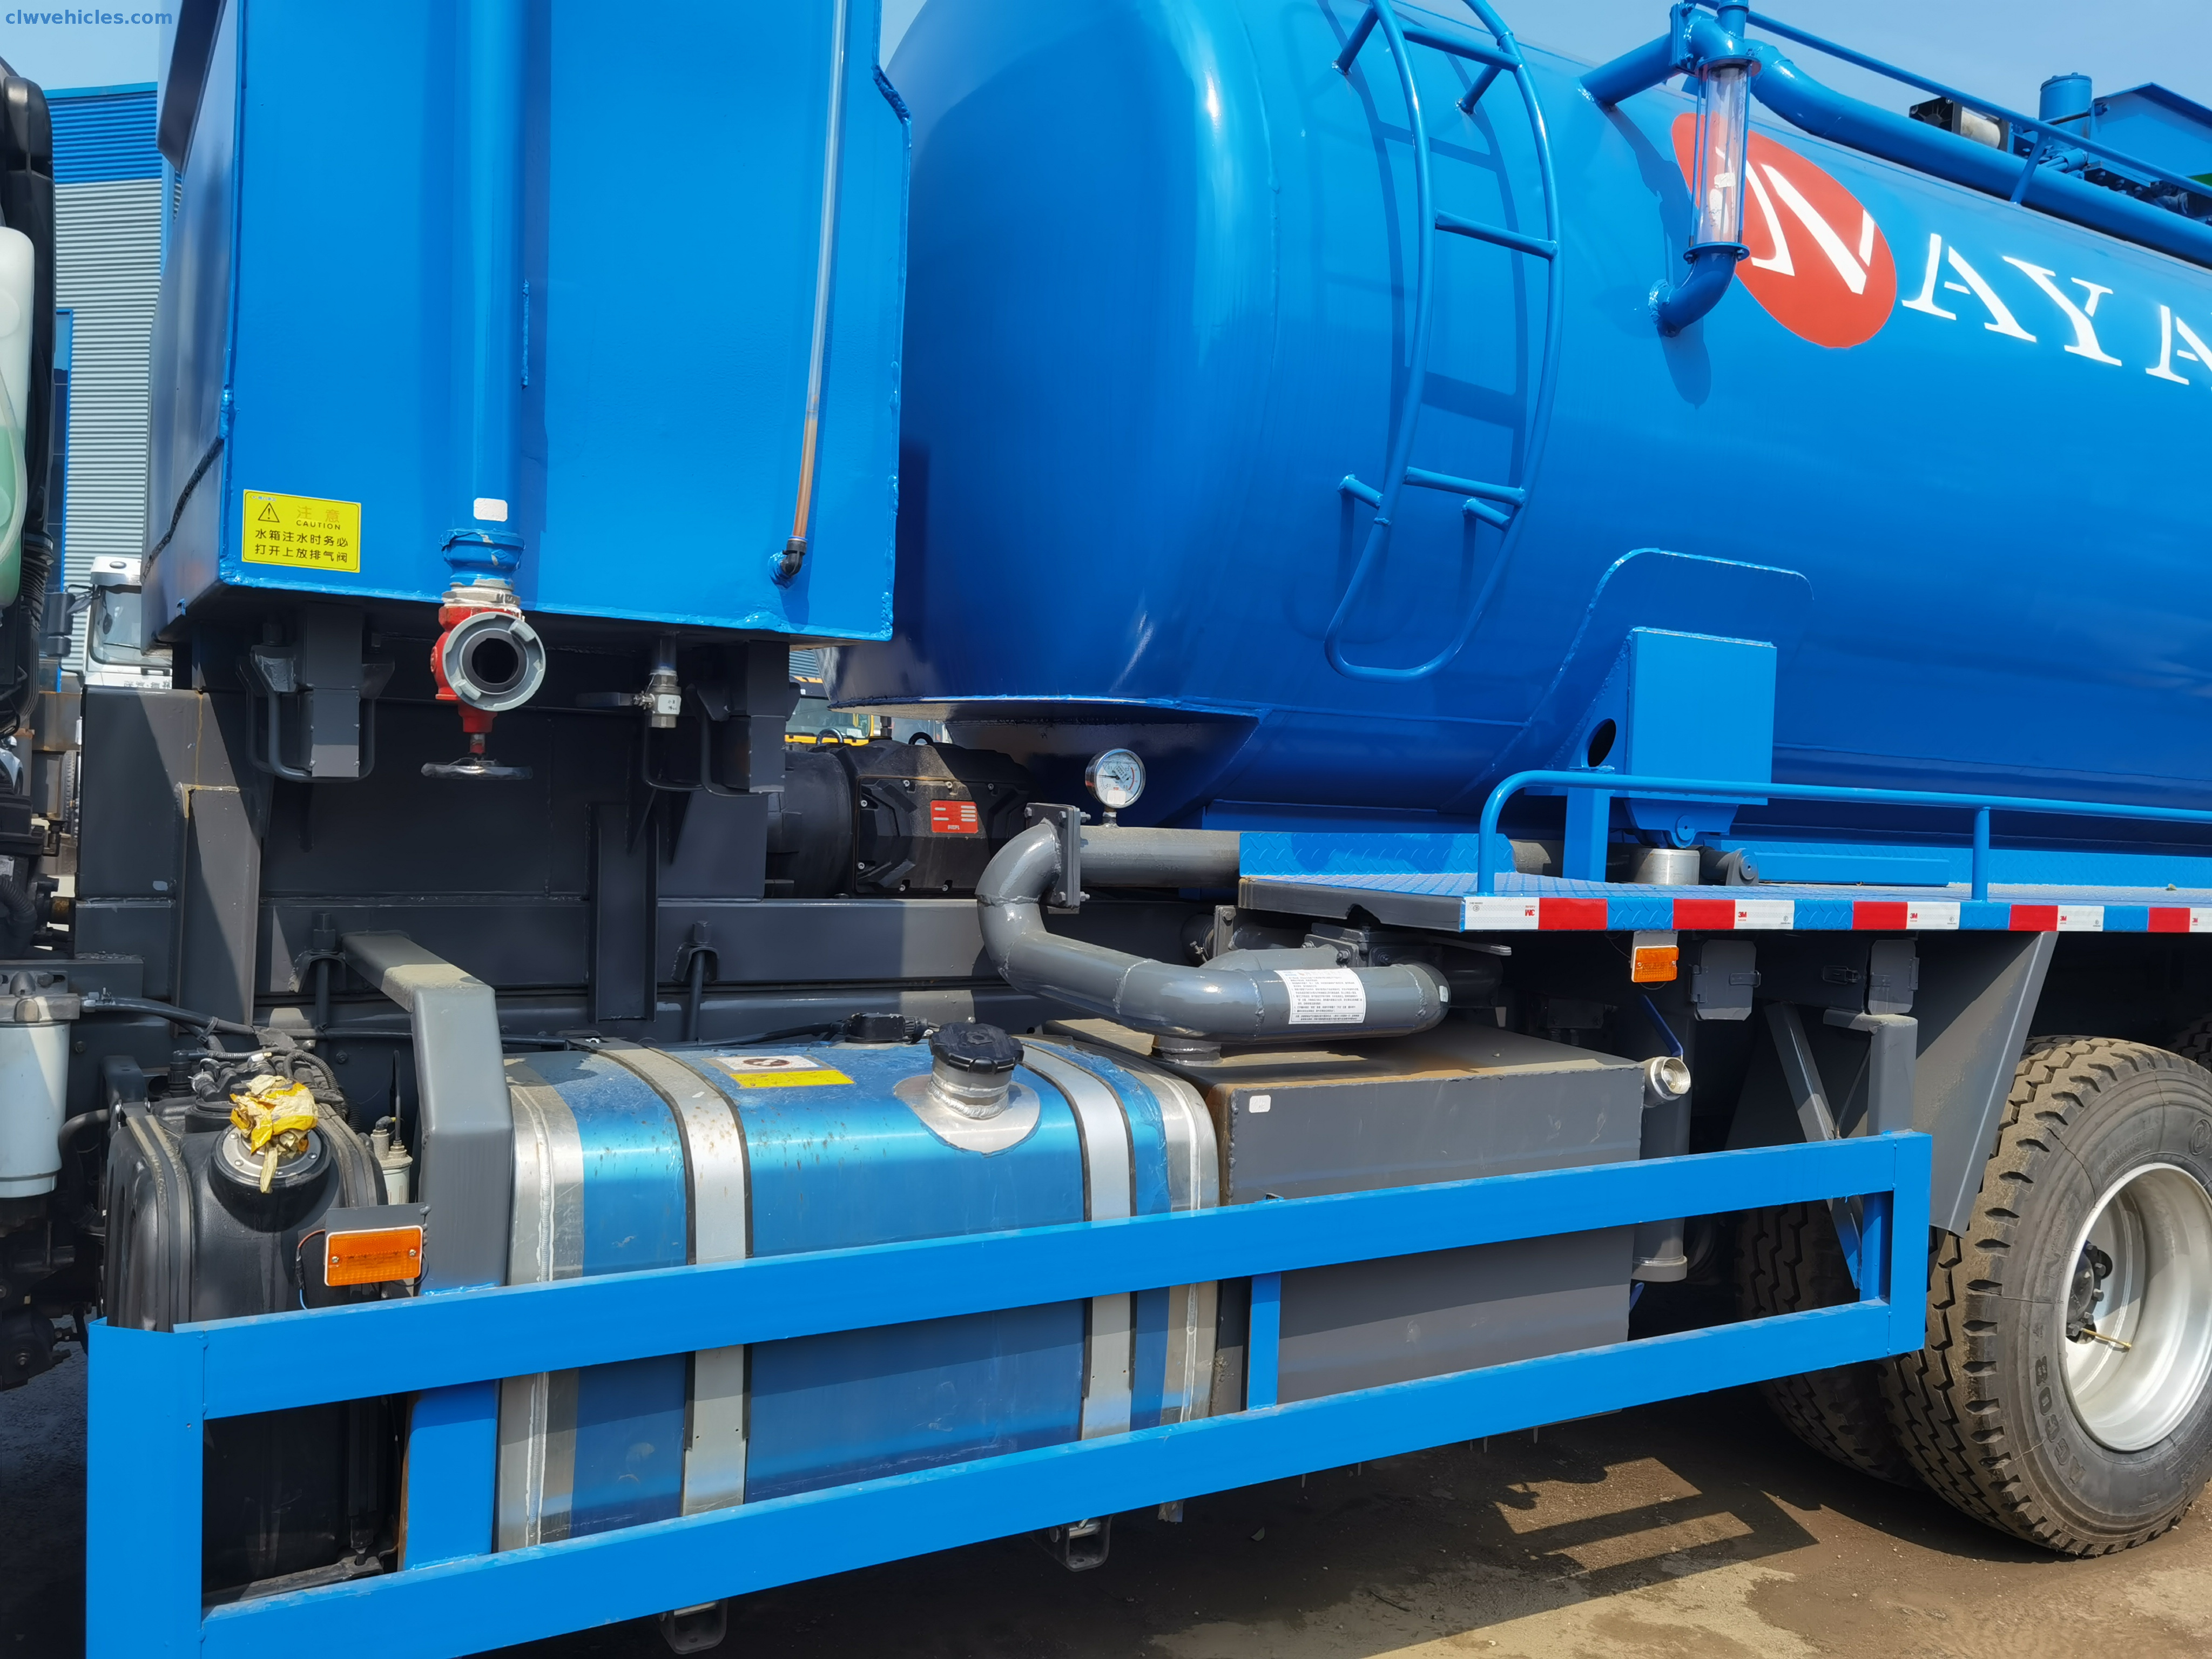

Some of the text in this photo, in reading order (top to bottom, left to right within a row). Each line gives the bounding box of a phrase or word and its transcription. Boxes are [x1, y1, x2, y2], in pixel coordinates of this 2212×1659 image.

[296, 505, 340, 523] 注意
[296, 520, 340, 530] CAUTION
[255, 528, 348, 548] 水箱注水时务必
[255, 543, 348, 563] 打开上放排气阀
